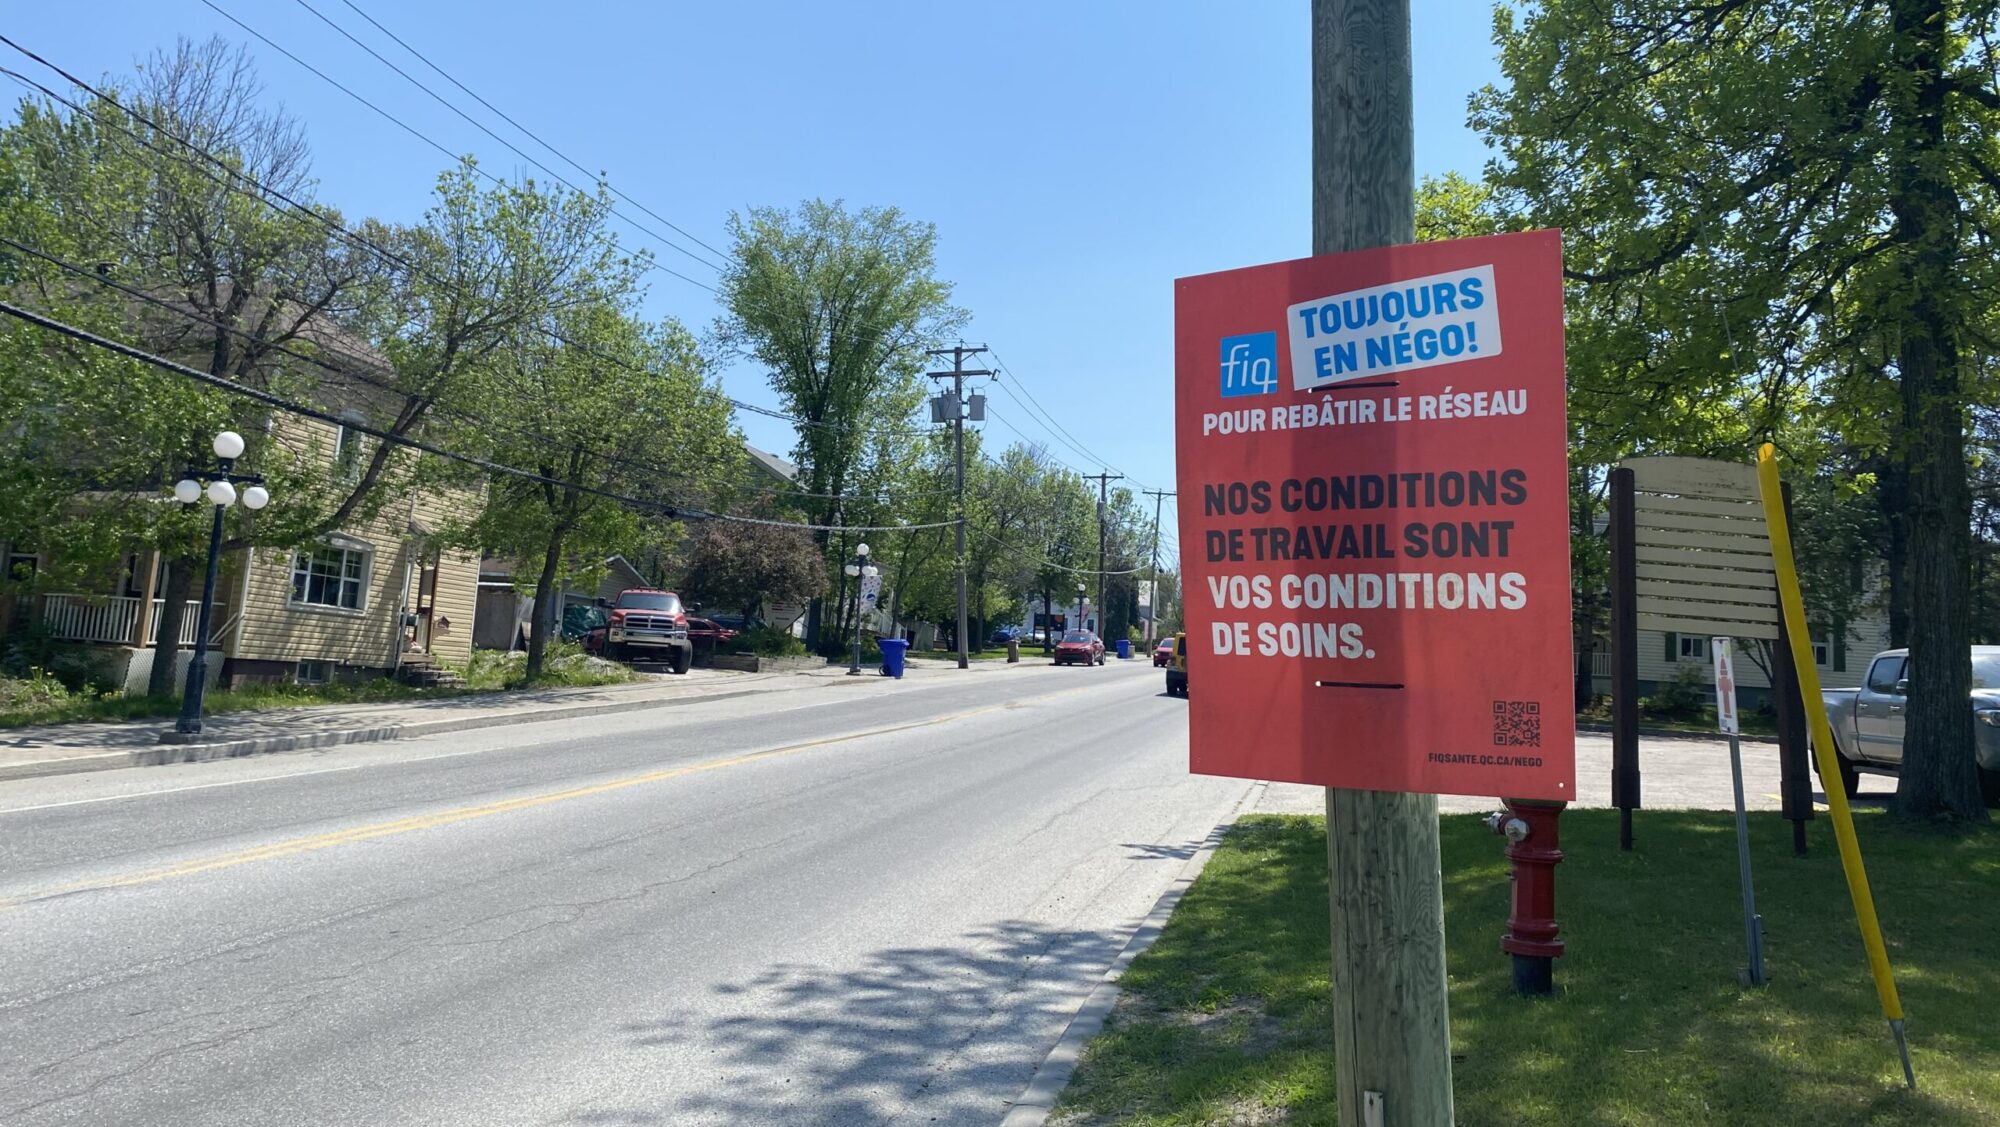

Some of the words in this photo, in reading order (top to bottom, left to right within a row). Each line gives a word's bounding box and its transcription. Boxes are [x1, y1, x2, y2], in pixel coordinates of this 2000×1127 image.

[1300, 277, 1484, 338] TOUJOURS
[1314, 341, 1358, 378] EN
[1366, 321, 1478, 370] NÉGO!
[1203, 408, 1266, 436] POUR
[1271, 394, 1376, 430] REBÂTIR
[1384, 395, 1412, 422] LE
[1419, 386, 1527, 420] RÉSEAU
[1204, 480, 1272, 516] NOS
[1280, 468, 1528, 513] CONDITIONS
[1206, 529, 1244, 562] DE
[1250, 523, 1395, 561] TRAVAIL
[1404, 521, 1514, 558] SONT
[1207, 575, 1273, 609] VOS
[1280, 572, 1527, 610] CONDITIONS
[1212, 622, 1251, 656] DE
[1257, 622, 1376, 659] SOINS.
